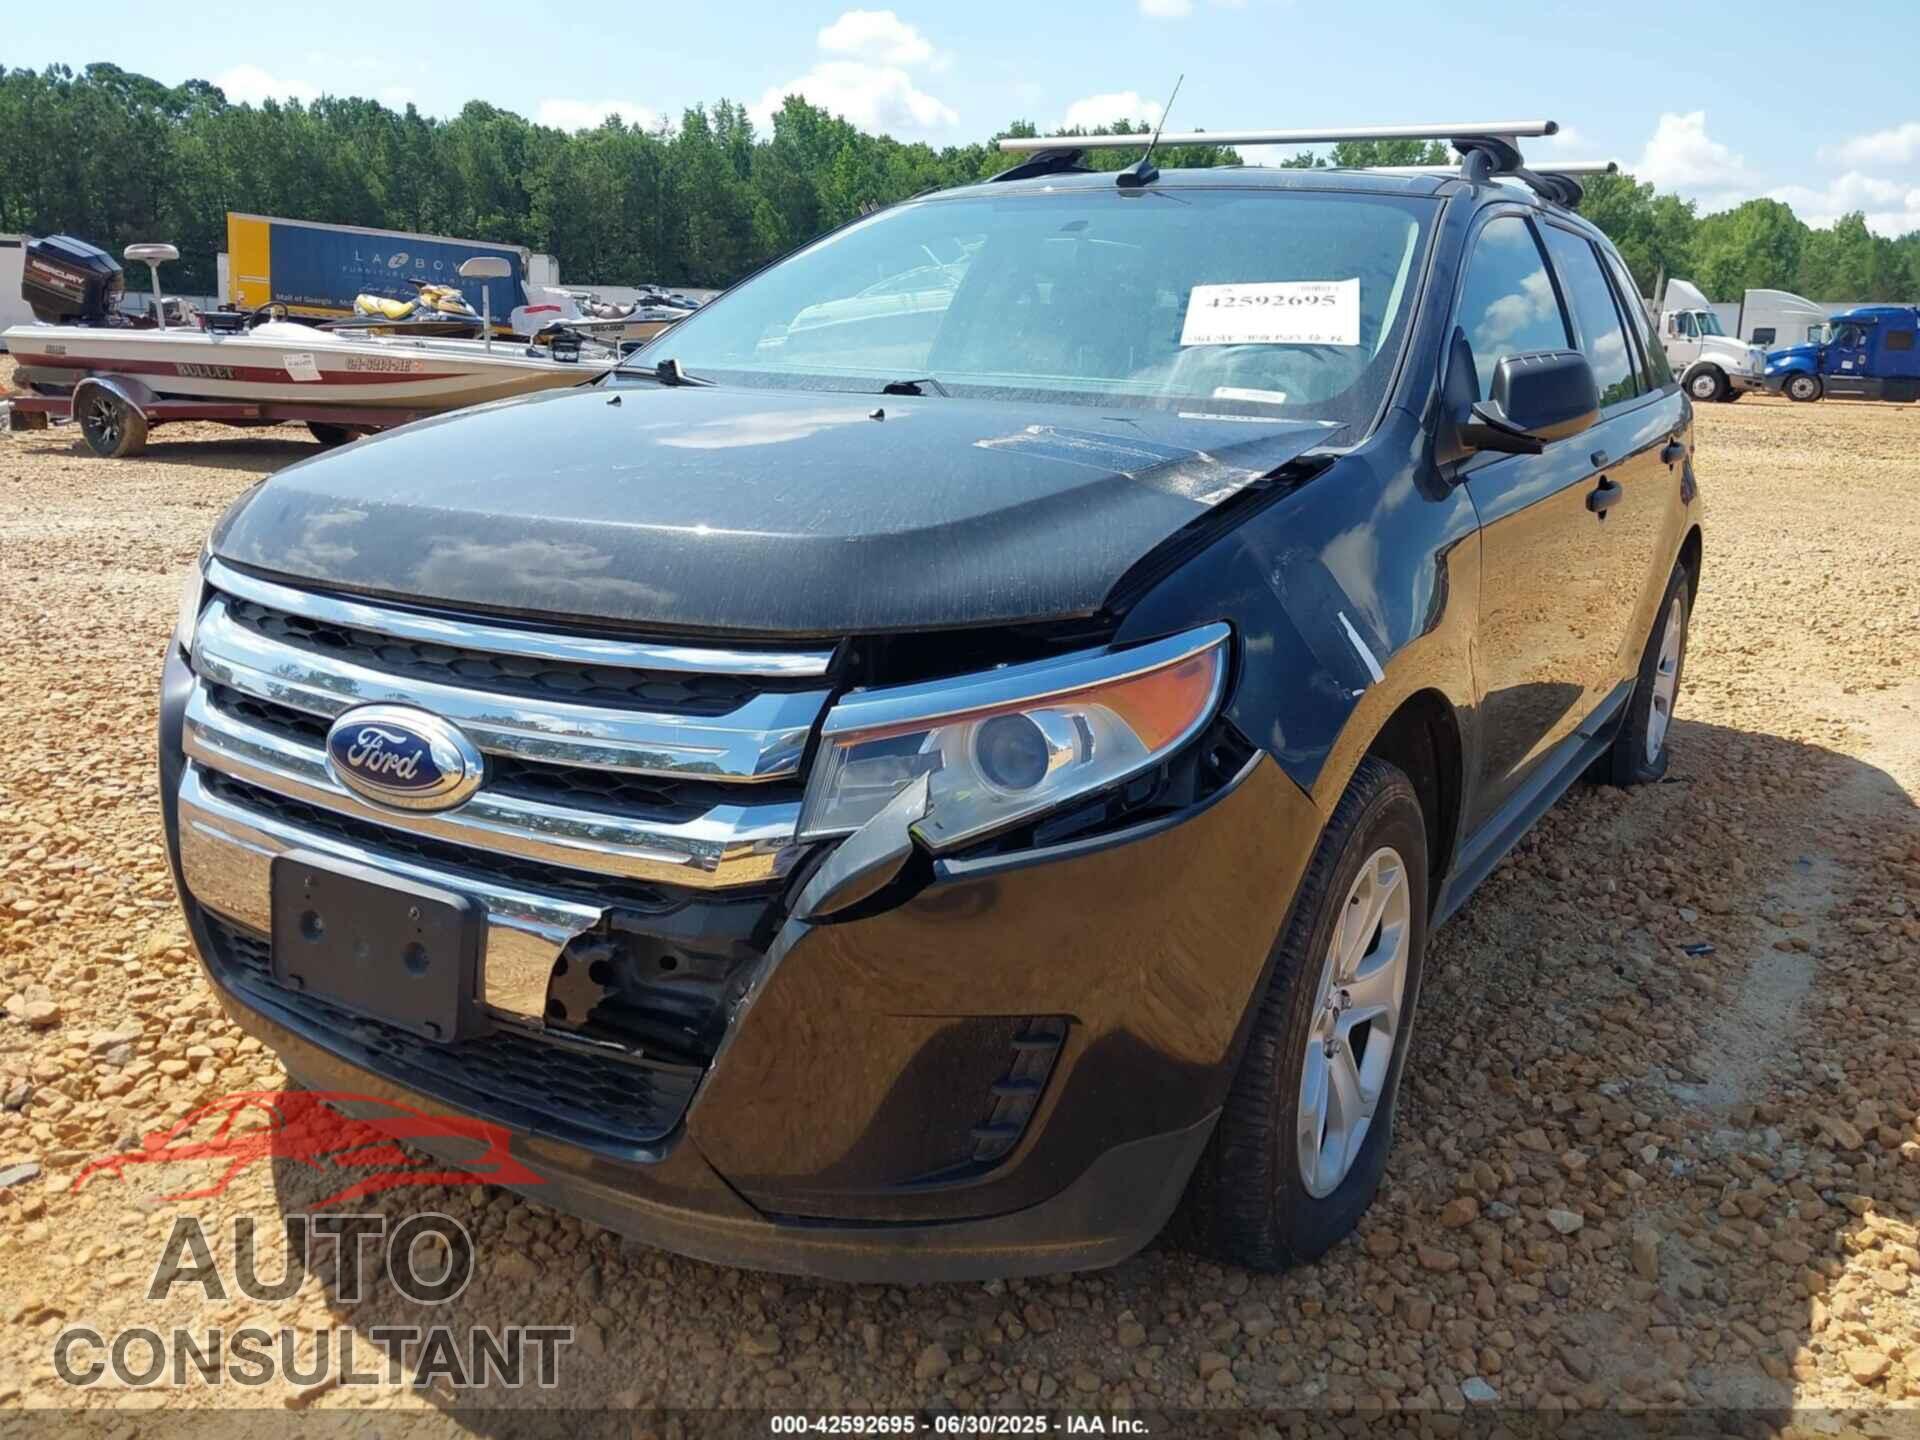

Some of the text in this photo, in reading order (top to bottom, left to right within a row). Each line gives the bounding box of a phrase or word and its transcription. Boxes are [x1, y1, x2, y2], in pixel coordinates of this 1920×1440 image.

[31, 259, 85, 284] MERCURY
[1205, 294, 1336, 308] 42592695
[347, 727, 423, 781] Ford
